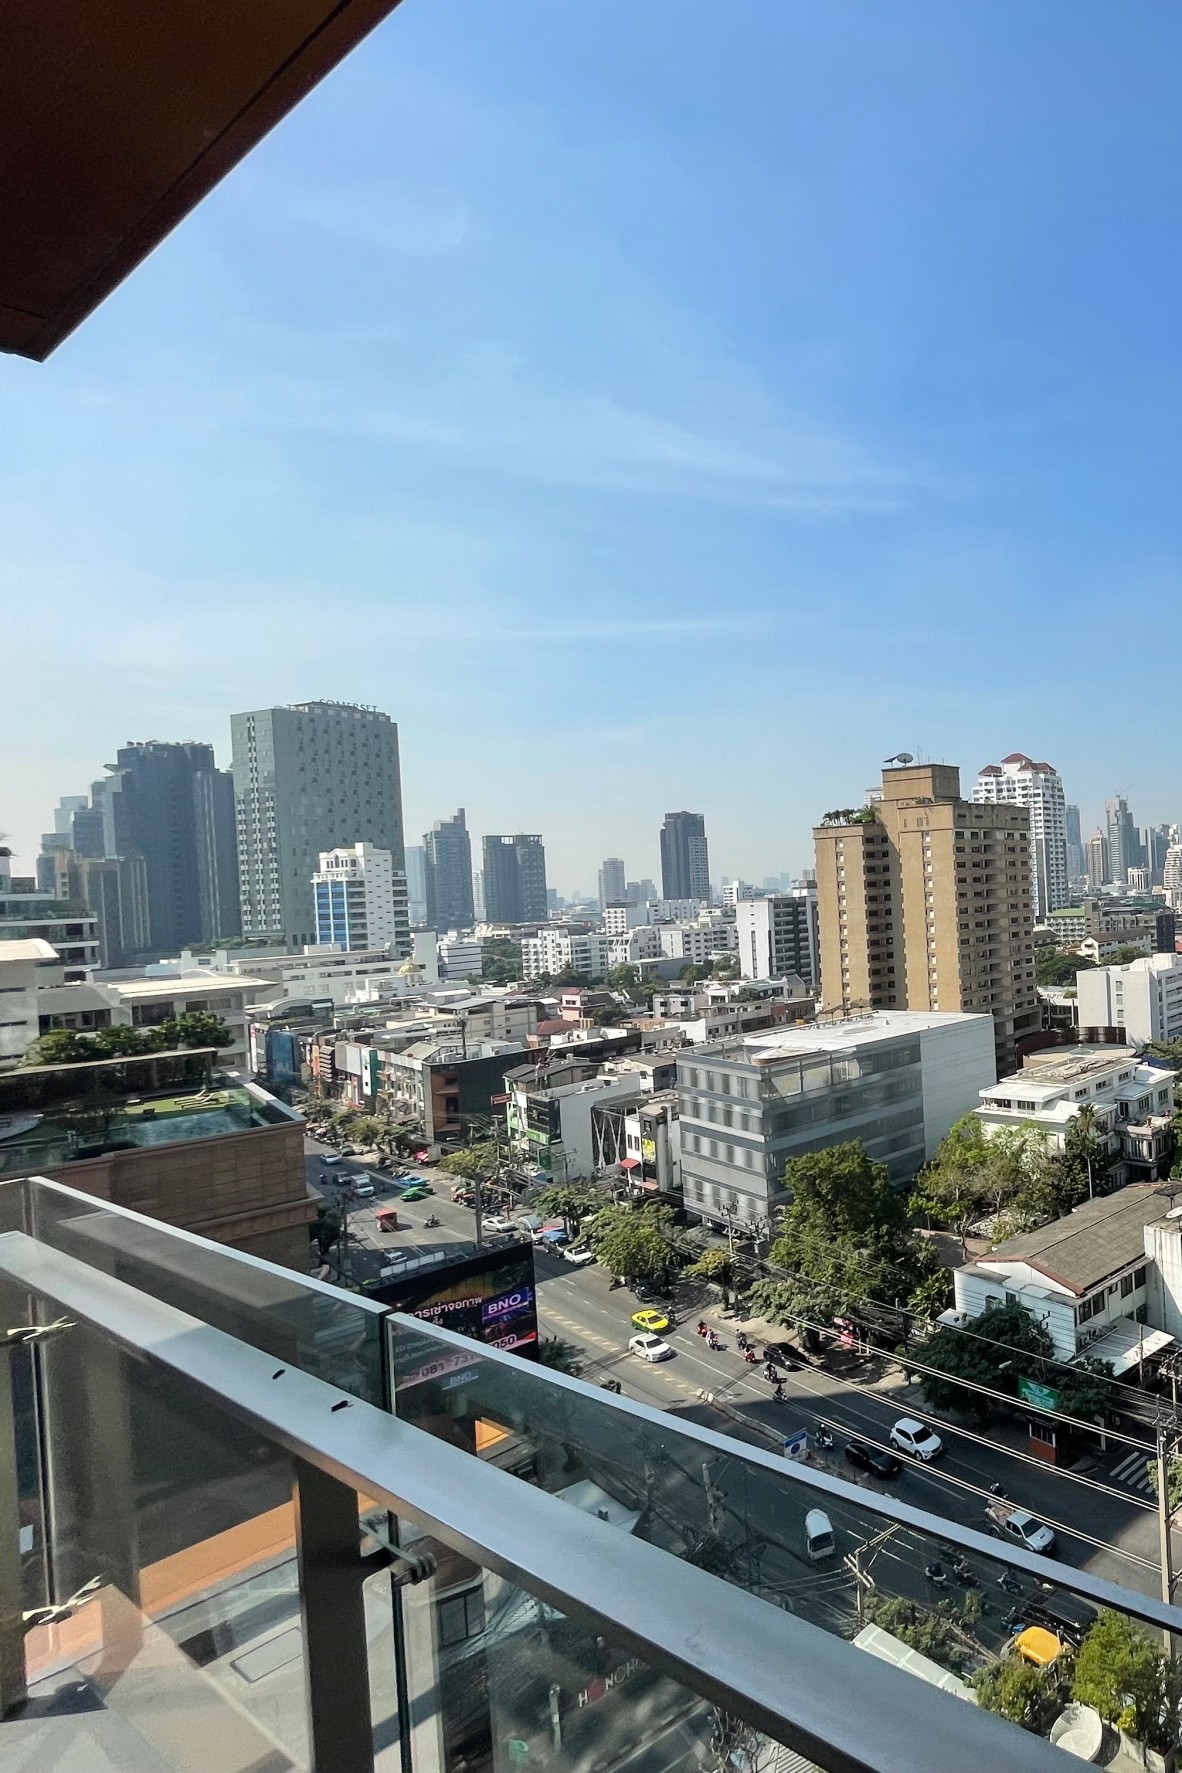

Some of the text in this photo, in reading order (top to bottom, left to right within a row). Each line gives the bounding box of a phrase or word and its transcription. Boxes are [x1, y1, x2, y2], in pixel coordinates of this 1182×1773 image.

[319, 698, 379, 714] SOMERSET
[488, 1293, 521, 1314] BNO
[450, 1371, 472, 1386] BNO
